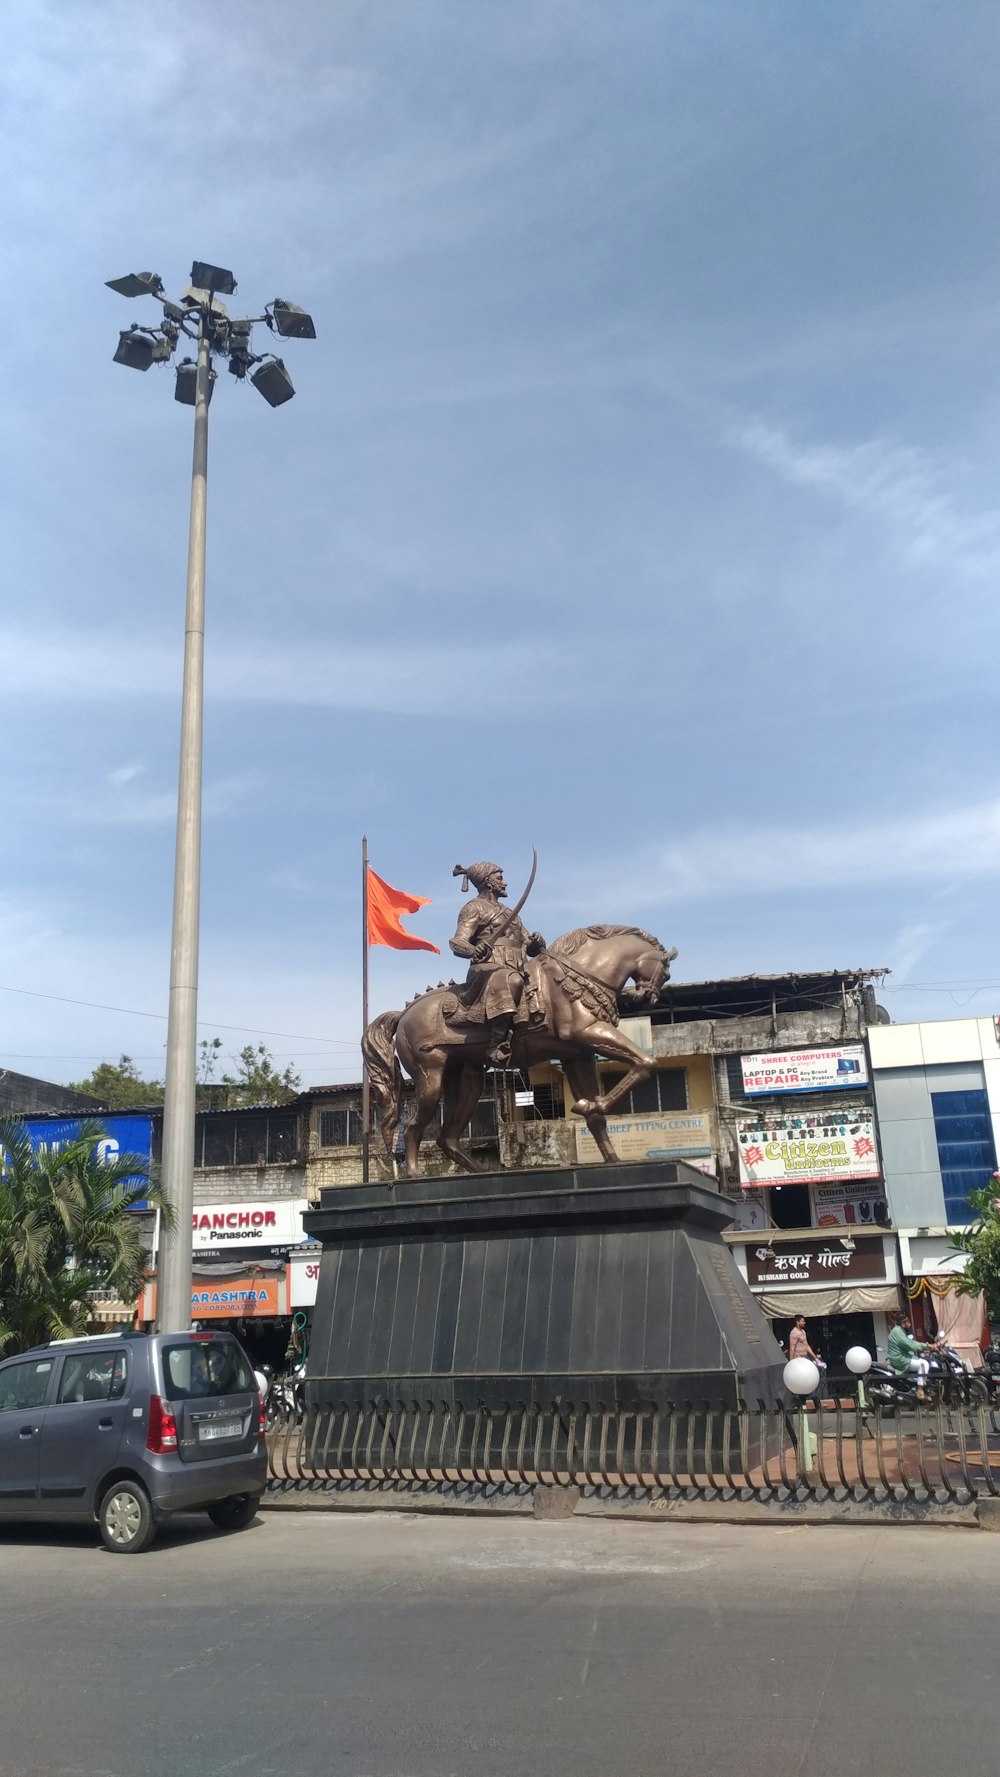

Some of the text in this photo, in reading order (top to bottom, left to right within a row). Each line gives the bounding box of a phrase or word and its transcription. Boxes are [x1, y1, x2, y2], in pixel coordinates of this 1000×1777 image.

[761, 1056, 788, 1065] SHREE
[790, 1052, 842, 1062] COMPUTERS
[744, 1069, 777, 1078] LAPTOP
[744, 1074, 799, 1087] REPAIR
[635, 1121, 667, 1132] TYPING
[668, 1118, 704, 1129] CENTRE
[765, 1140, 847, 1160] Citizen
[784, 1156, 851, 1170] Uniforms
[818, 1184, 879, 1197] Citizen Uniforms
[198, 1211, 277, 1230] ANCHOR
[210, 1229, 263, 1240] Panasonic
[774, 1247, 853, 1270] ऋषभ गोल्ड
[790, 1272, 810, 1280] GOLD
[204, 1302, 259, 1312] CORPORATION
